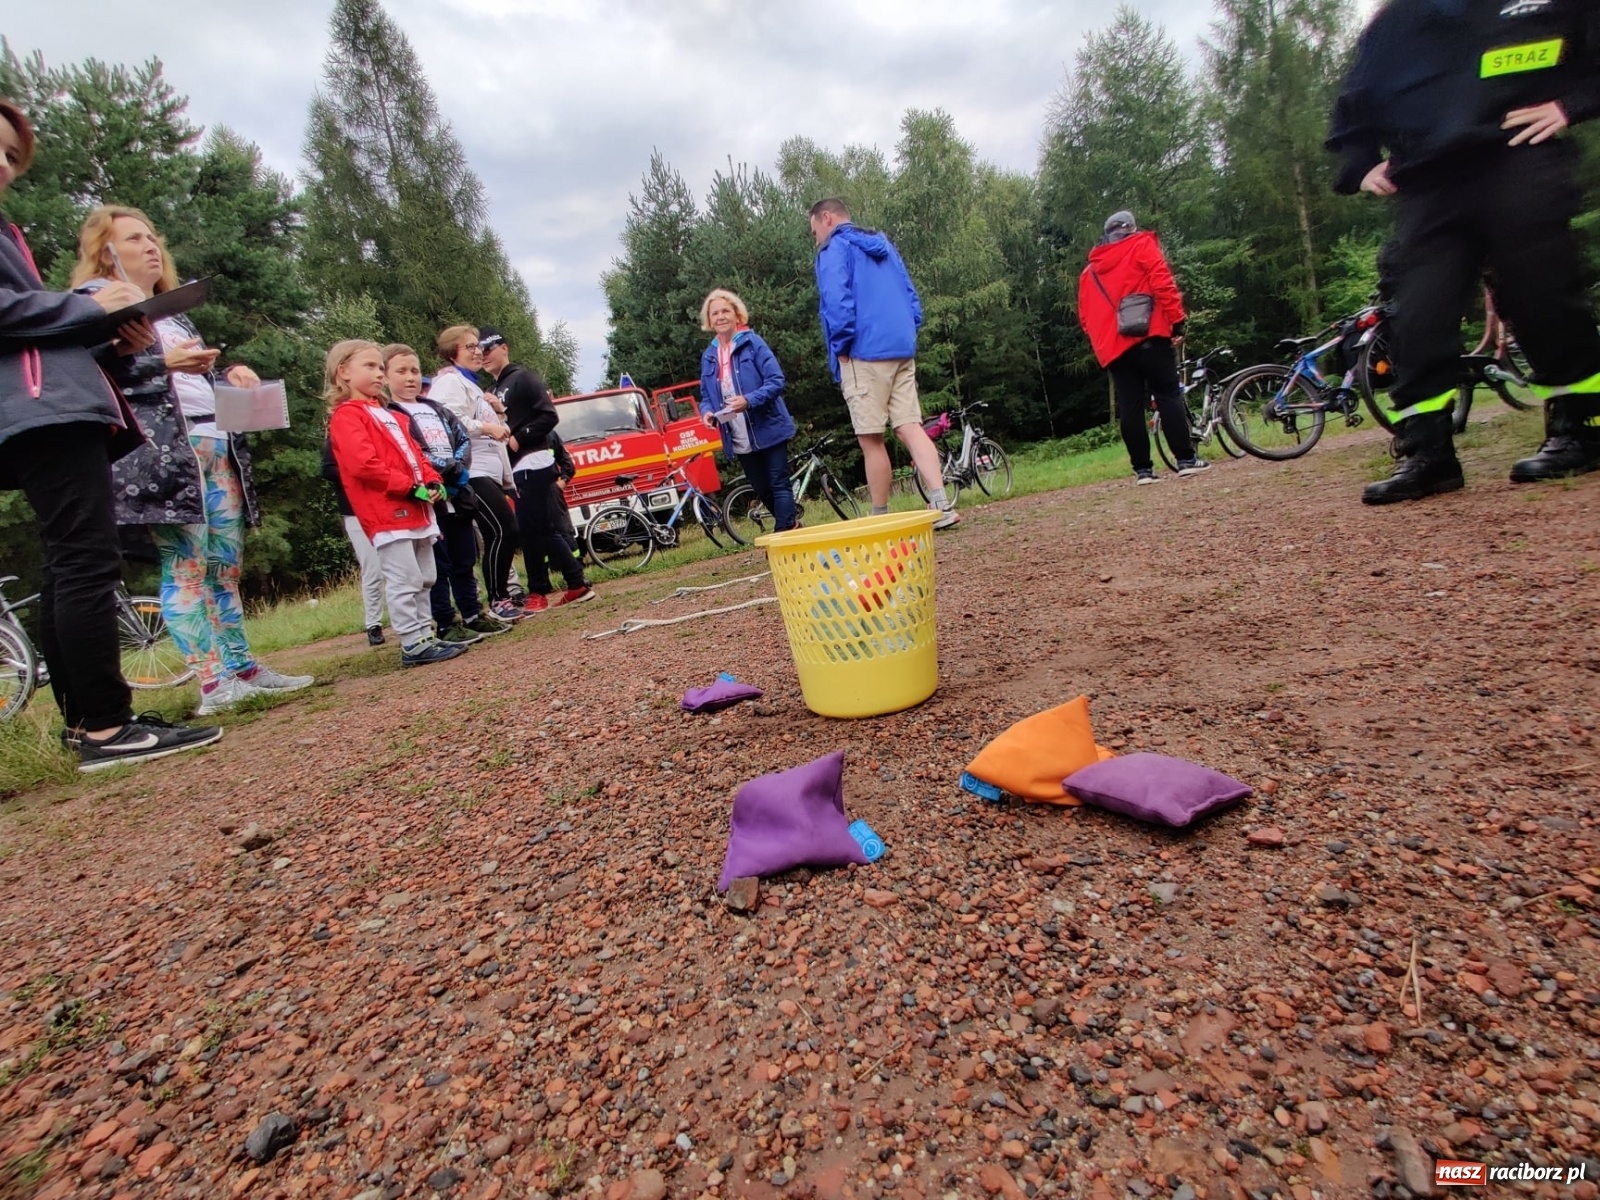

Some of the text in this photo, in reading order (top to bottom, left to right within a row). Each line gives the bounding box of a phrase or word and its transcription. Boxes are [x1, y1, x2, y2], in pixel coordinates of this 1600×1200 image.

[679, 430, 695, 439] OSP
[672, 438, 709, 452] KOZIELSKA
[680, 436, 699, 446] RUDA
